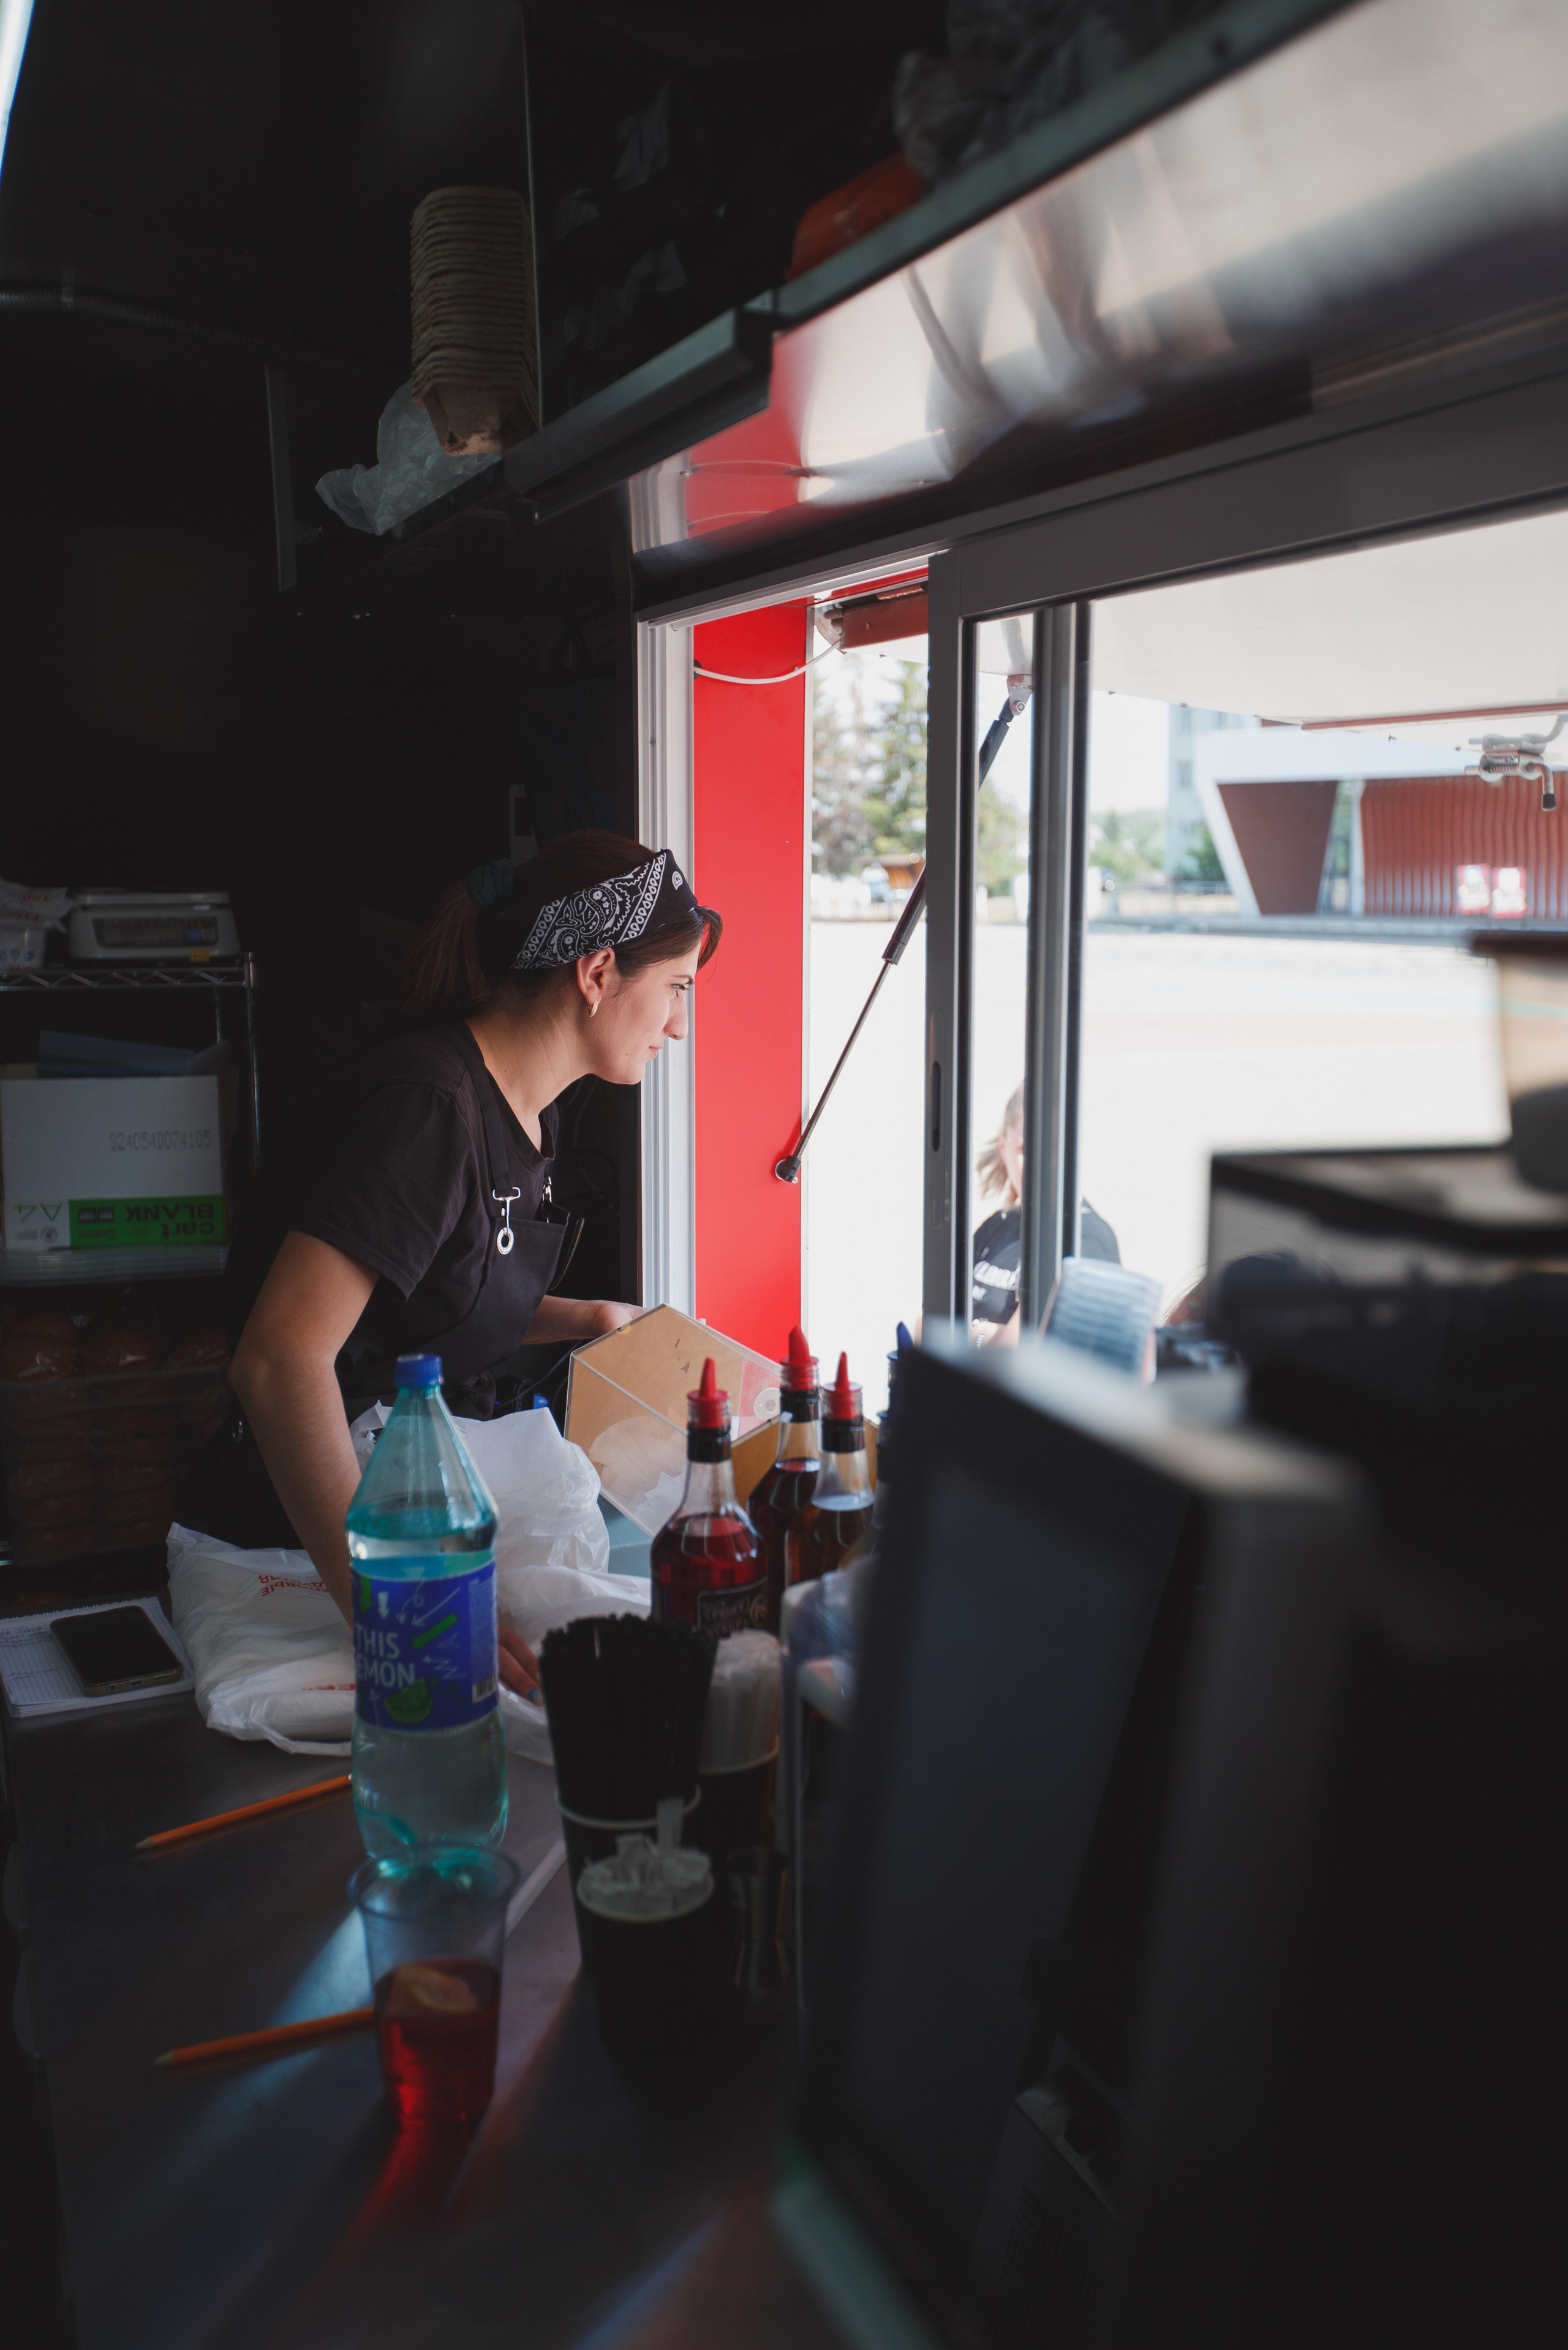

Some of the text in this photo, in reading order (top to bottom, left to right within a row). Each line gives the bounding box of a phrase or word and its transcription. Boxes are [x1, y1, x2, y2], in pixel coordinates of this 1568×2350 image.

[12, 1202, 62, 1224] A4
[125, 1202, 214, 1223] BLANK
[161, 1221, 214, 1239] cart
[355, 1624, 400, 1660] THIS
[356, 1653, 415, 1689] EMON
